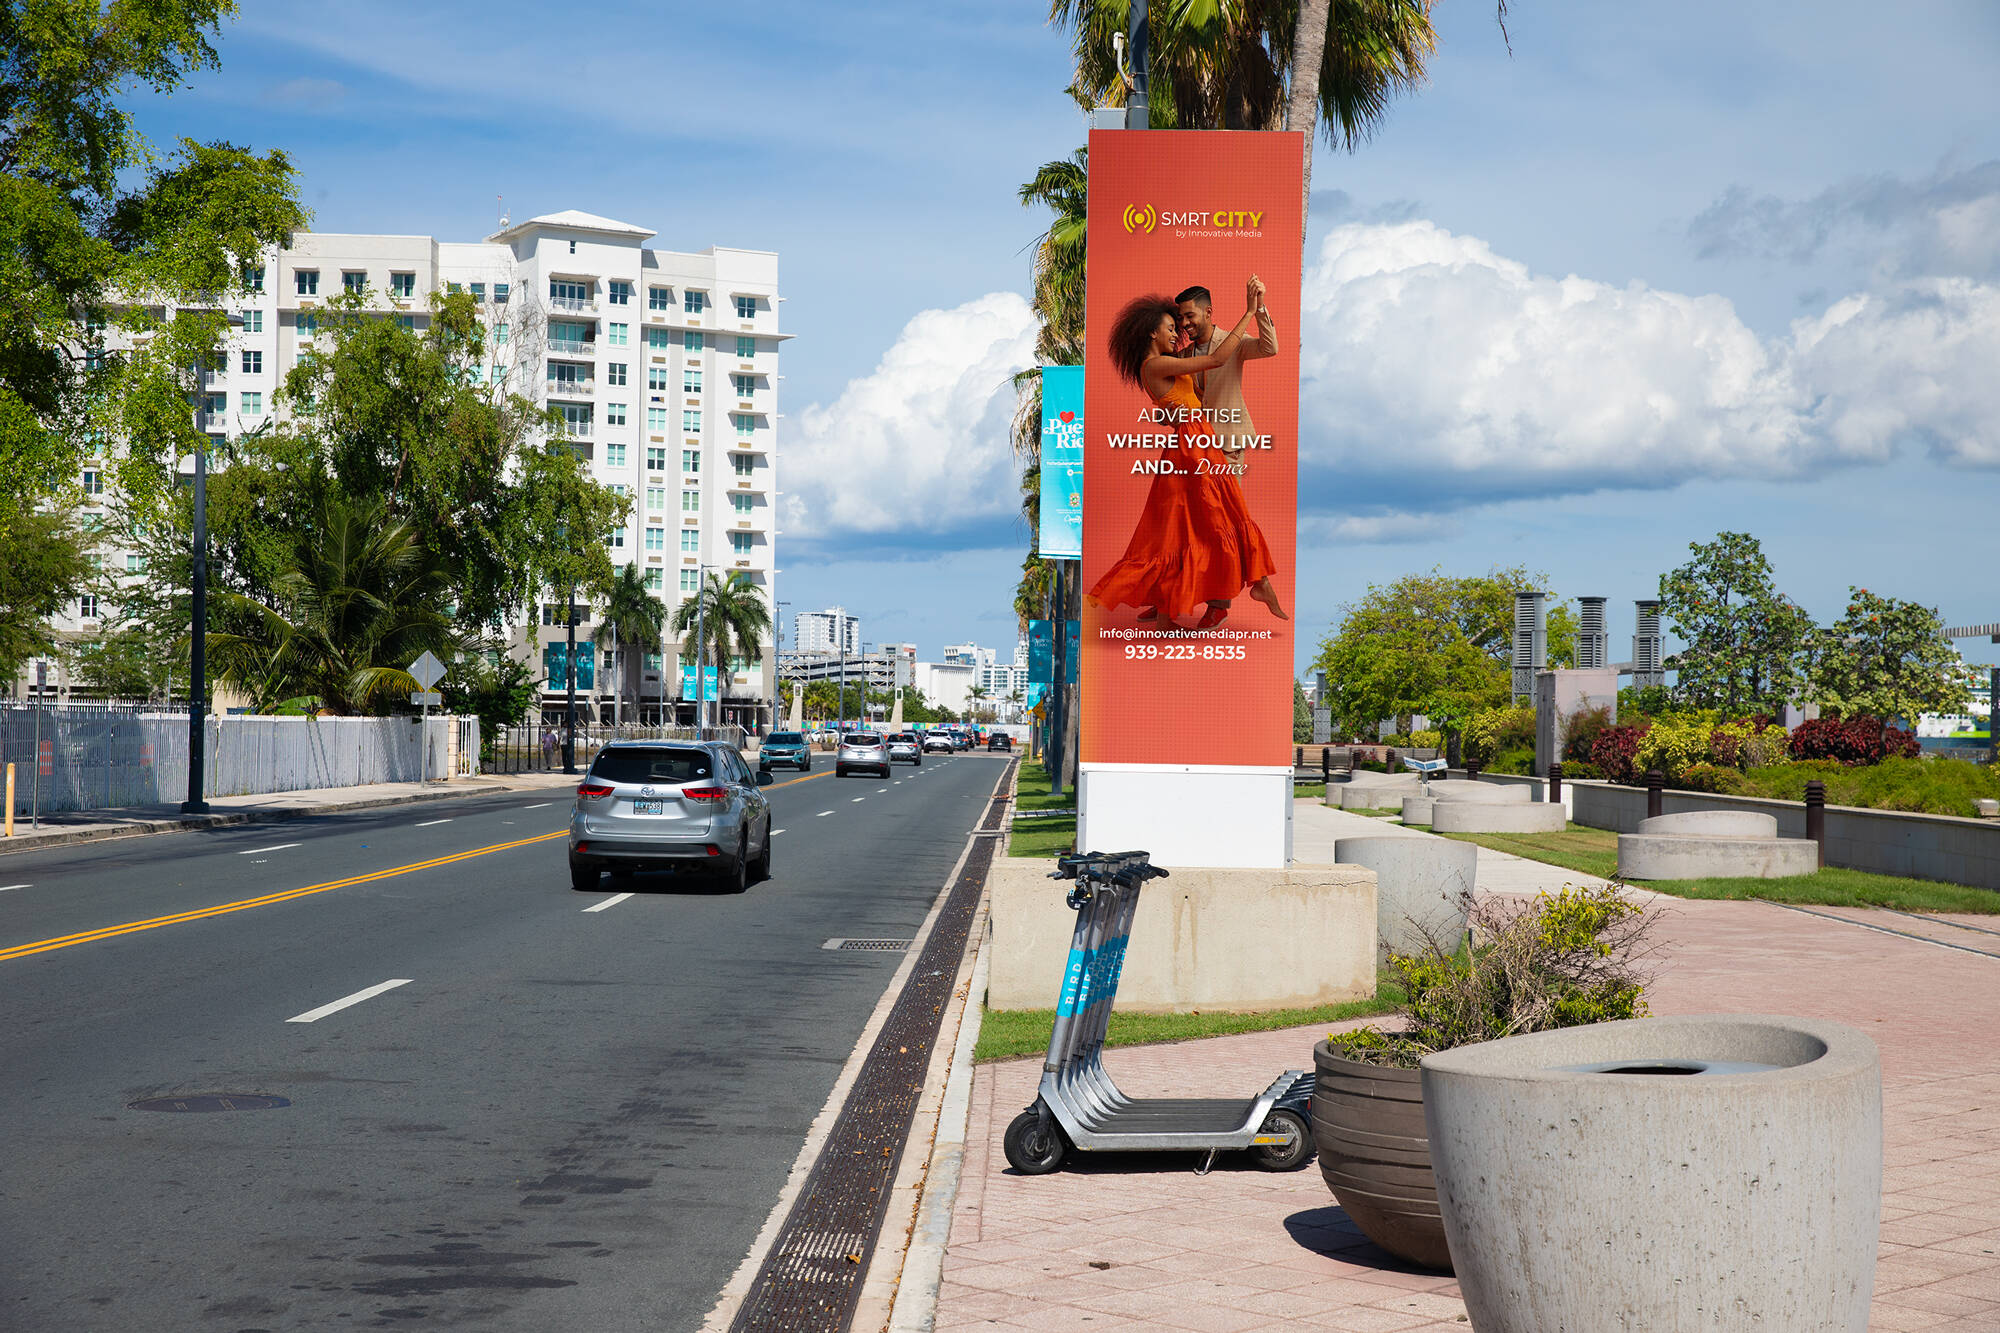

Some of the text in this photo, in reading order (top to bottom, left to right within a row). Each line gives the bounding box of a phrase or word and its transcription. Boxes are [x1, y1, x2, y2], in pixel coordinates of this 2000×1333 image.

[1161, 211, 1263, 227] SMRT CITY
[1176, 229, 1262, 238] by Innovative Media
[1137, 408, 1241, 423] ADVERTISE
[1043, 418, 1084, 434] Pue
[1107, 434, 1272, 449] WHERE YOU LIVE
[1131, 458, 1248, 475] AND... Dance
[1099, 628, 1272, 641] info@innovativemediapr.net
[1124, 645, 1246, 660] 939-223-8535
[1065, 963, 1082, 1005] BIRD
